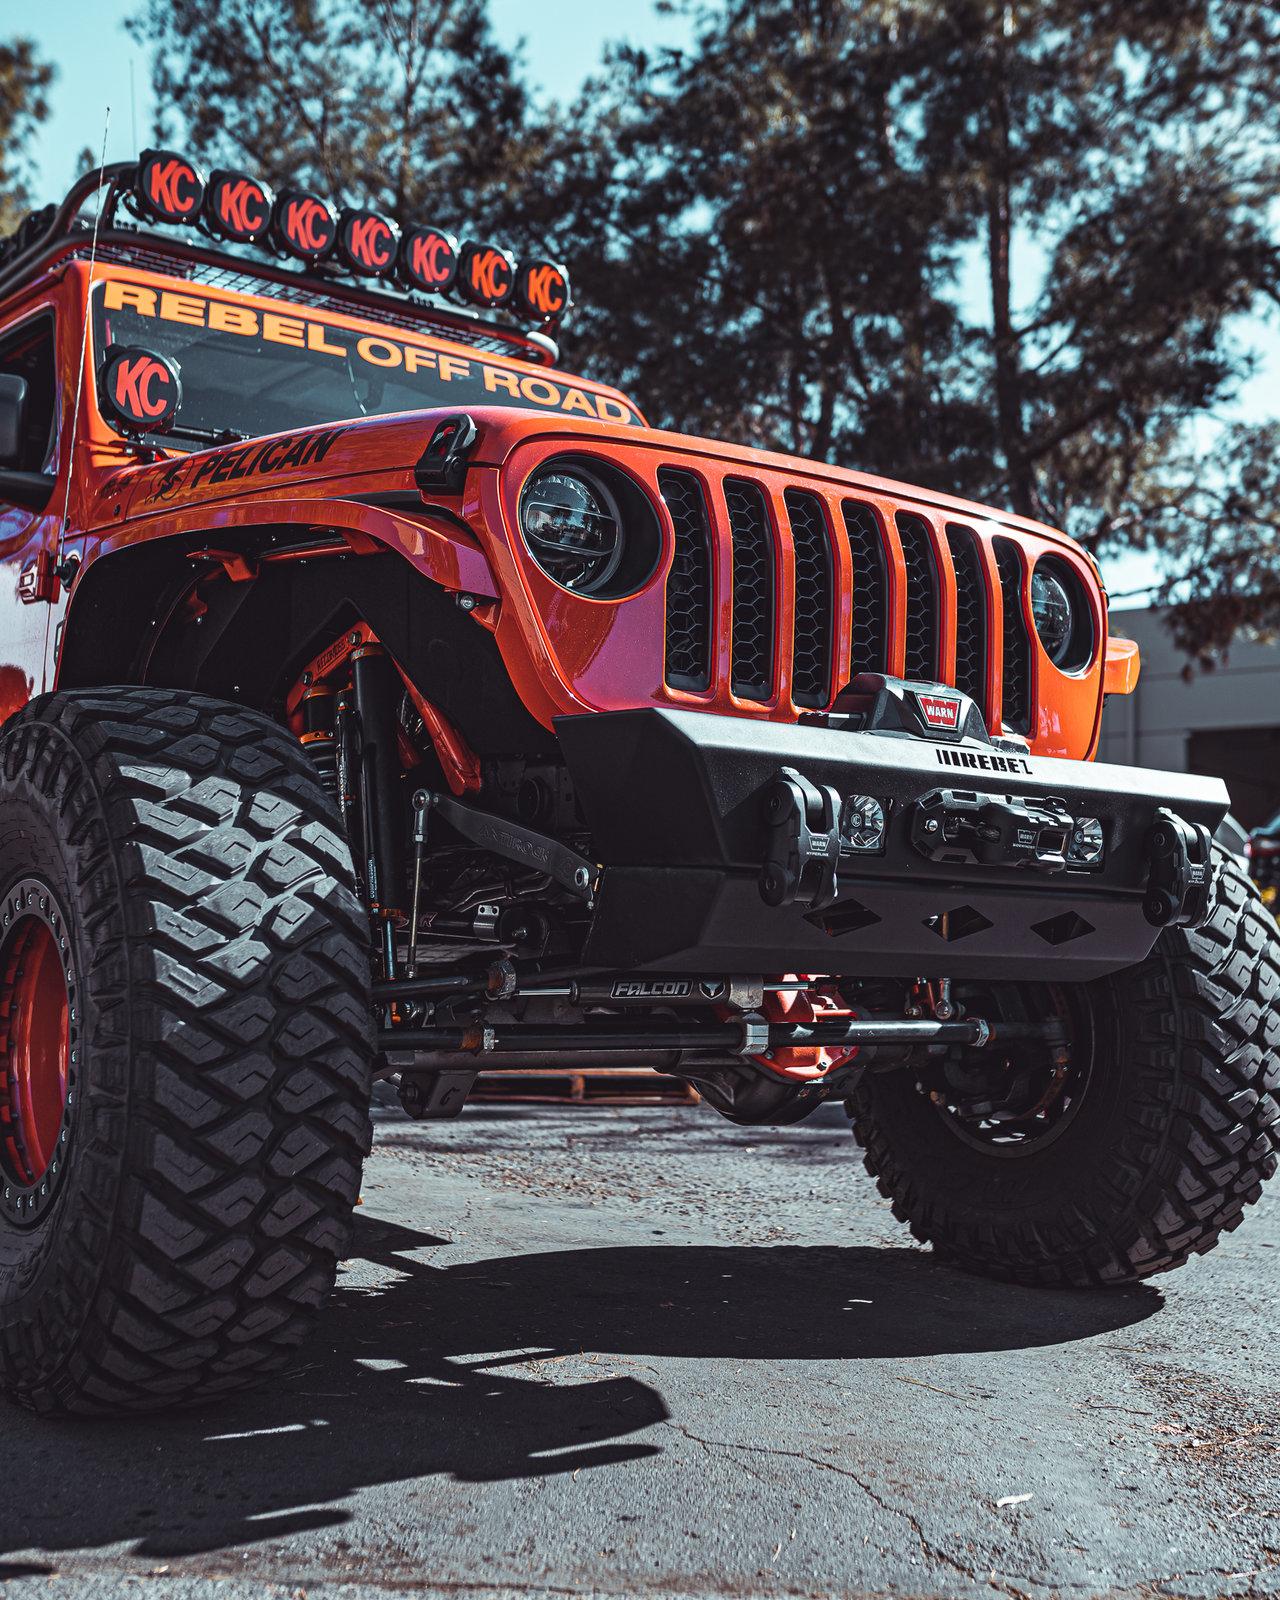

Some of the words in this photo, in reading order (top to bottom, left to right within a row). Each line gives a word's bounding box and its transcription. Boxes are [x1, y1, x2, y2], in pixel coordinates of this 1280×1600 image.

[151, 161, 194, 212] KC
[221, 181, 263, 231] KC
[288, 200, 327, 249] KC
[352, 218, 390, 266] KC
[413, 235, 450, 282] KC
[472, 251, 507, 298] KC
[529, 266, 562, 312] KC
[104, 280, 347, 358] REBEL
[357, 337, 471, 382] OFF
[482, 366, 632, 425] ROAD
[116, 357, 169, 417] KC
[190, 428, 346, 489] PELICAN
[926, 704, 954, 719] WARN
[480, 824, 551, 862] ANTIROCK
[615, 982, 689, 996] FALCON
